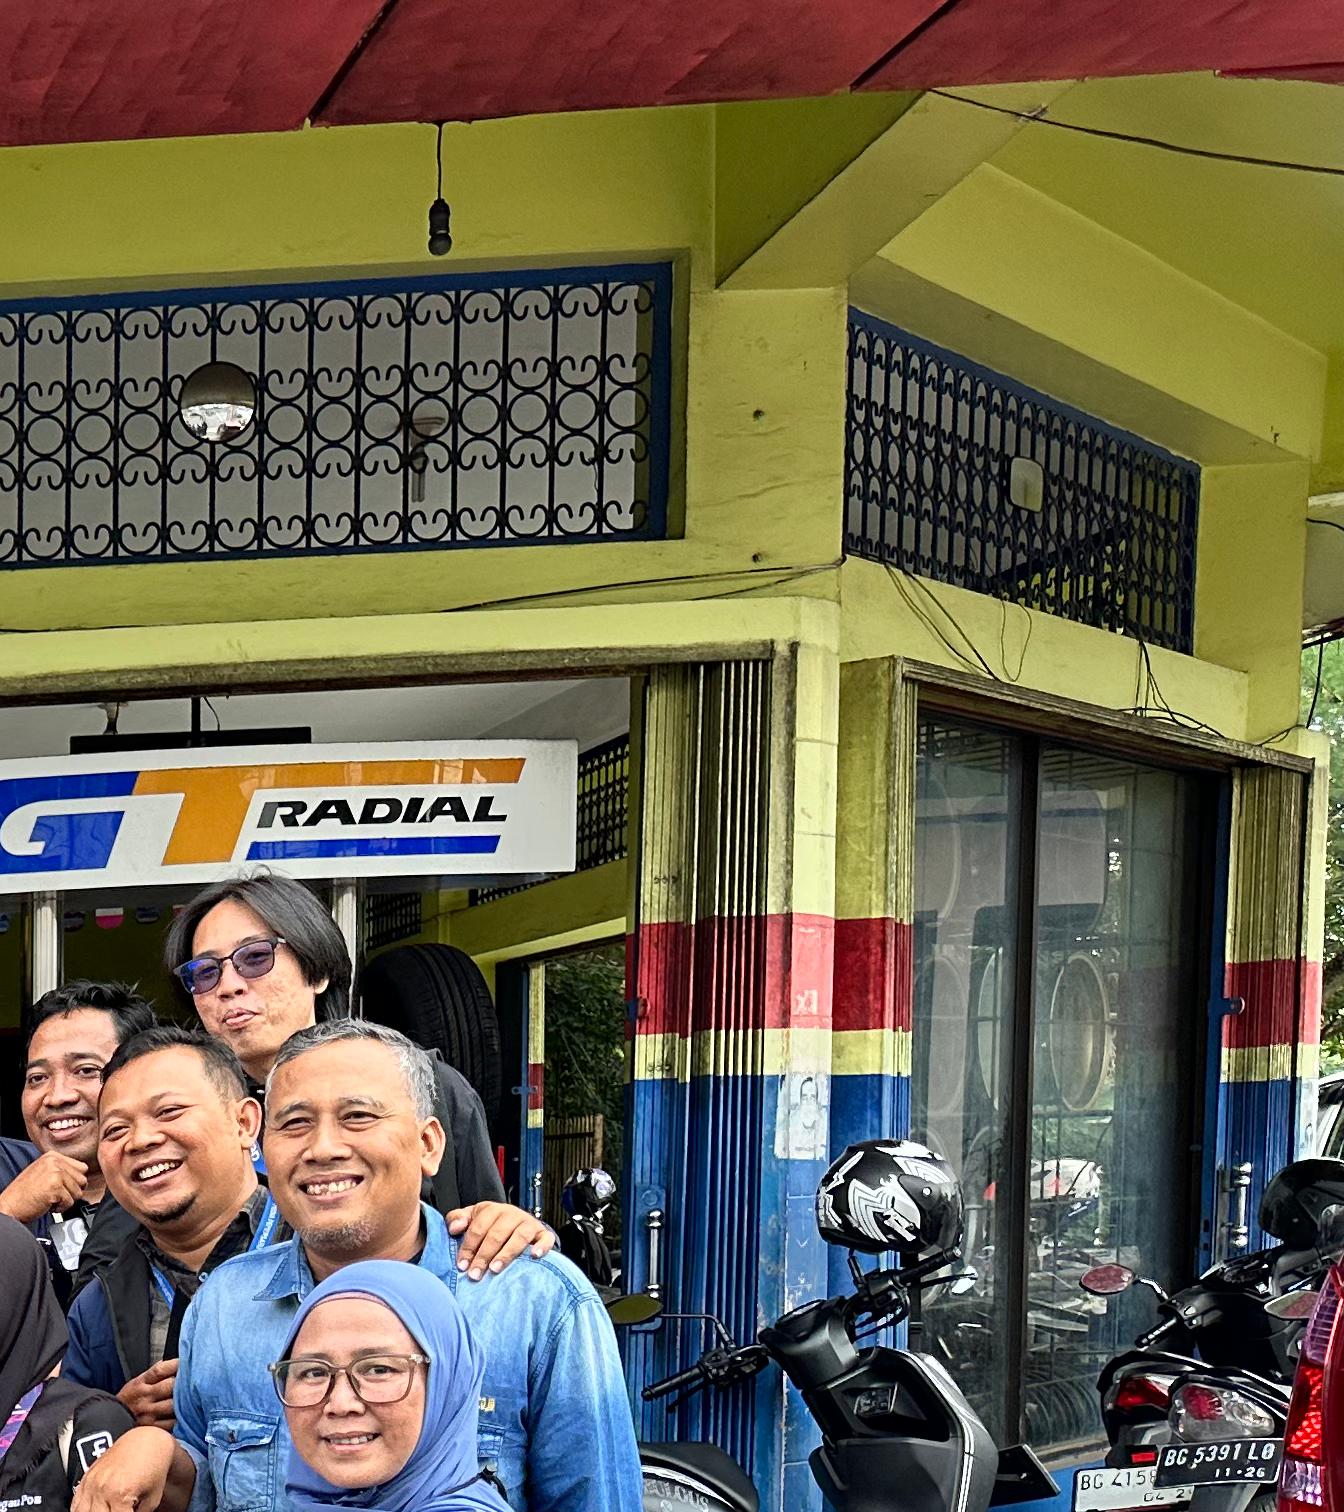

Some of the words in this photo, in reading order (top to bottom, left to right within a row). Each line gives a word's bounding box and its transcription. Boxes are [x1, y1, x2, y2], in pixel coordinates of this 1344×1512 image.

[256, 795, 508, 828] RADIAL
[1164, 1449, 1189, 1467] BG
[1195, 1442, 1241, 1465] 5391
[1080, 1474, 1104, 1491] BG
